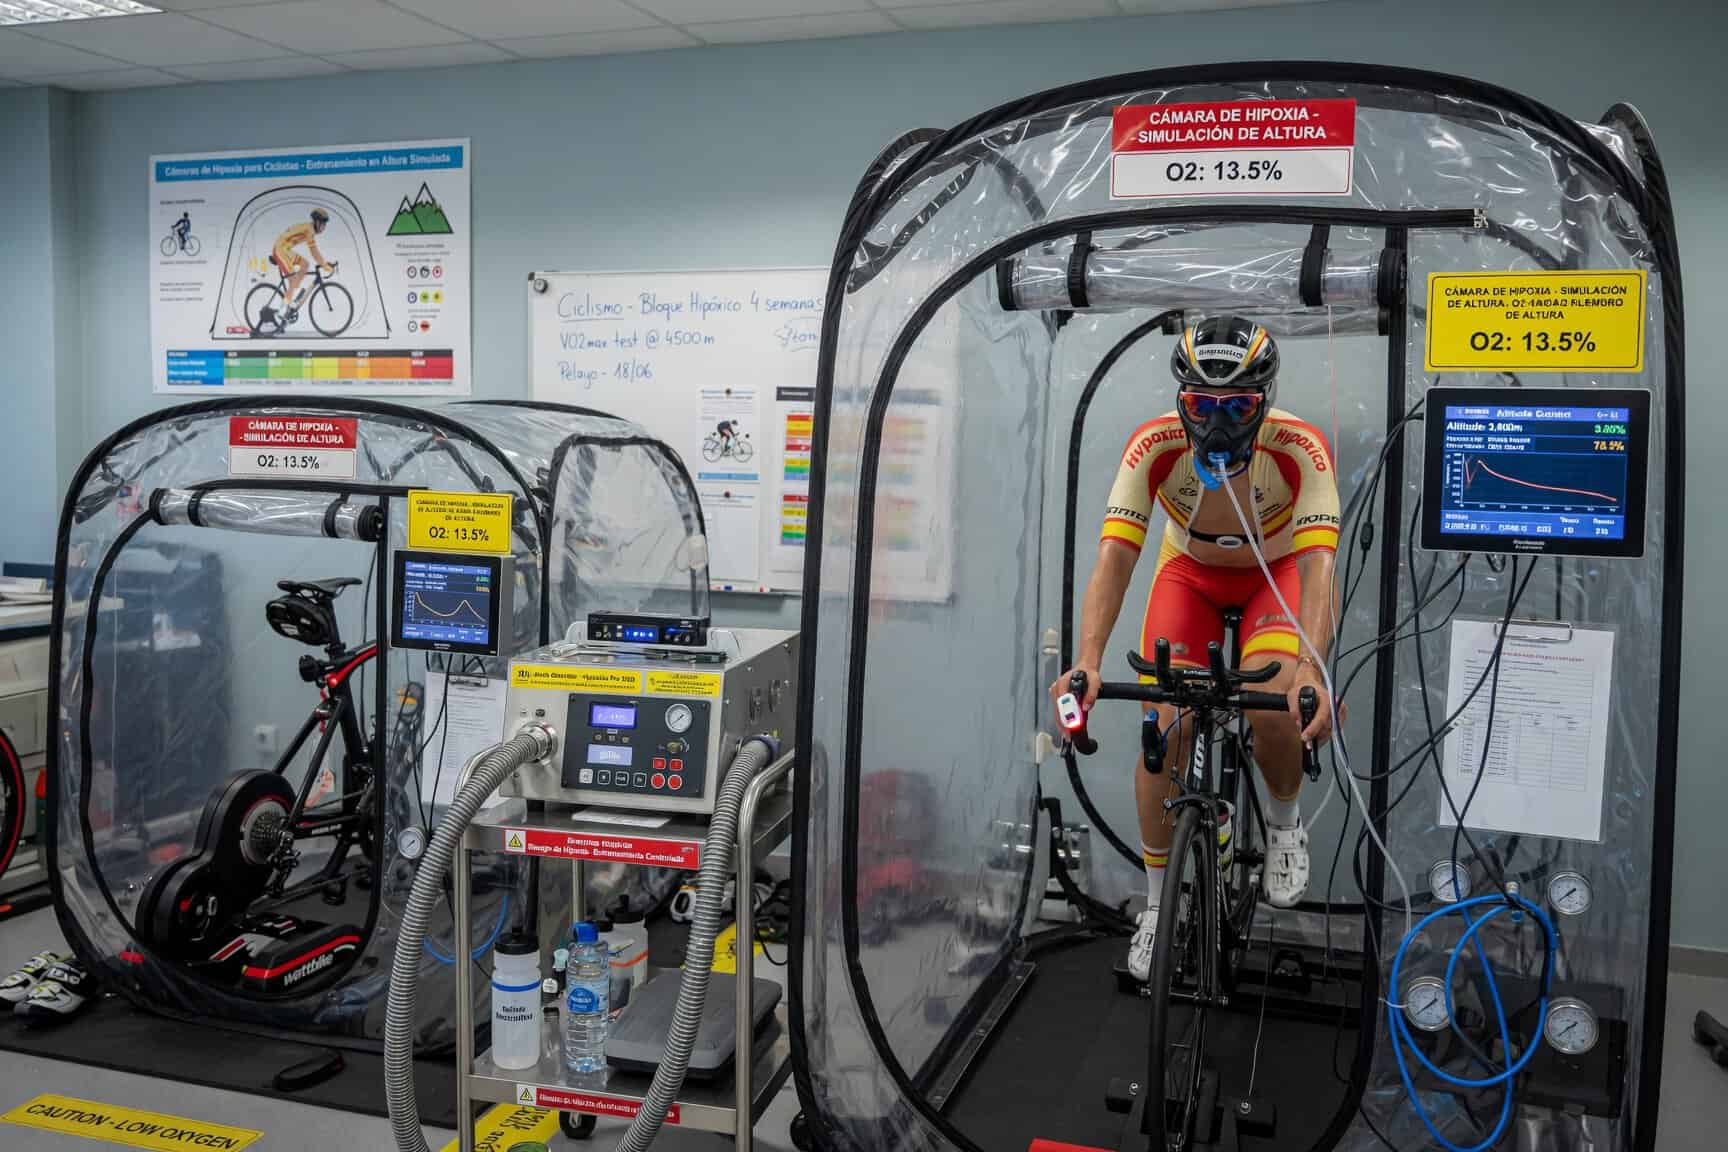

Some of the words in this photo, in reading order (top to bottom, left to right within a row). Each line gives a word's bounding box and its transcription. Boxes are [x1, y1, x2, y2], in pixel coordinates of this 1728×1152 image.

[1149, 110, 1217, 125] CÁMARA
[1220, 110, 1242, 123] DE
[1245, 107, 1310, 122] HIPOXIA
[1138, 126, 1234, 143] SIMULACIÓN
[1238, 127, 1260, 140] DE
[1263, 125, 1327, 140] ALTURA
[1165, 161, 1205, 182] O2:
[1214, 159, 1283, 181] 13.5%
[1492, 287, 1507, 296] DE
[1522, 310, 1565, 320] ALTURA
[1470, 331, 1512, 353] O2:
[1522, 331, 1597, 353] 13.5%
[257, 454, 278, 468] O2:
[284, 455, 320, 470] 13.5%
[453, 528, 489, 542] 13.5%
[26, 1103, 111, 1126] CAUTION
[114, 1119, 162, 1136] LOW
[159, 1127, 240, 1150] OXYGEN
